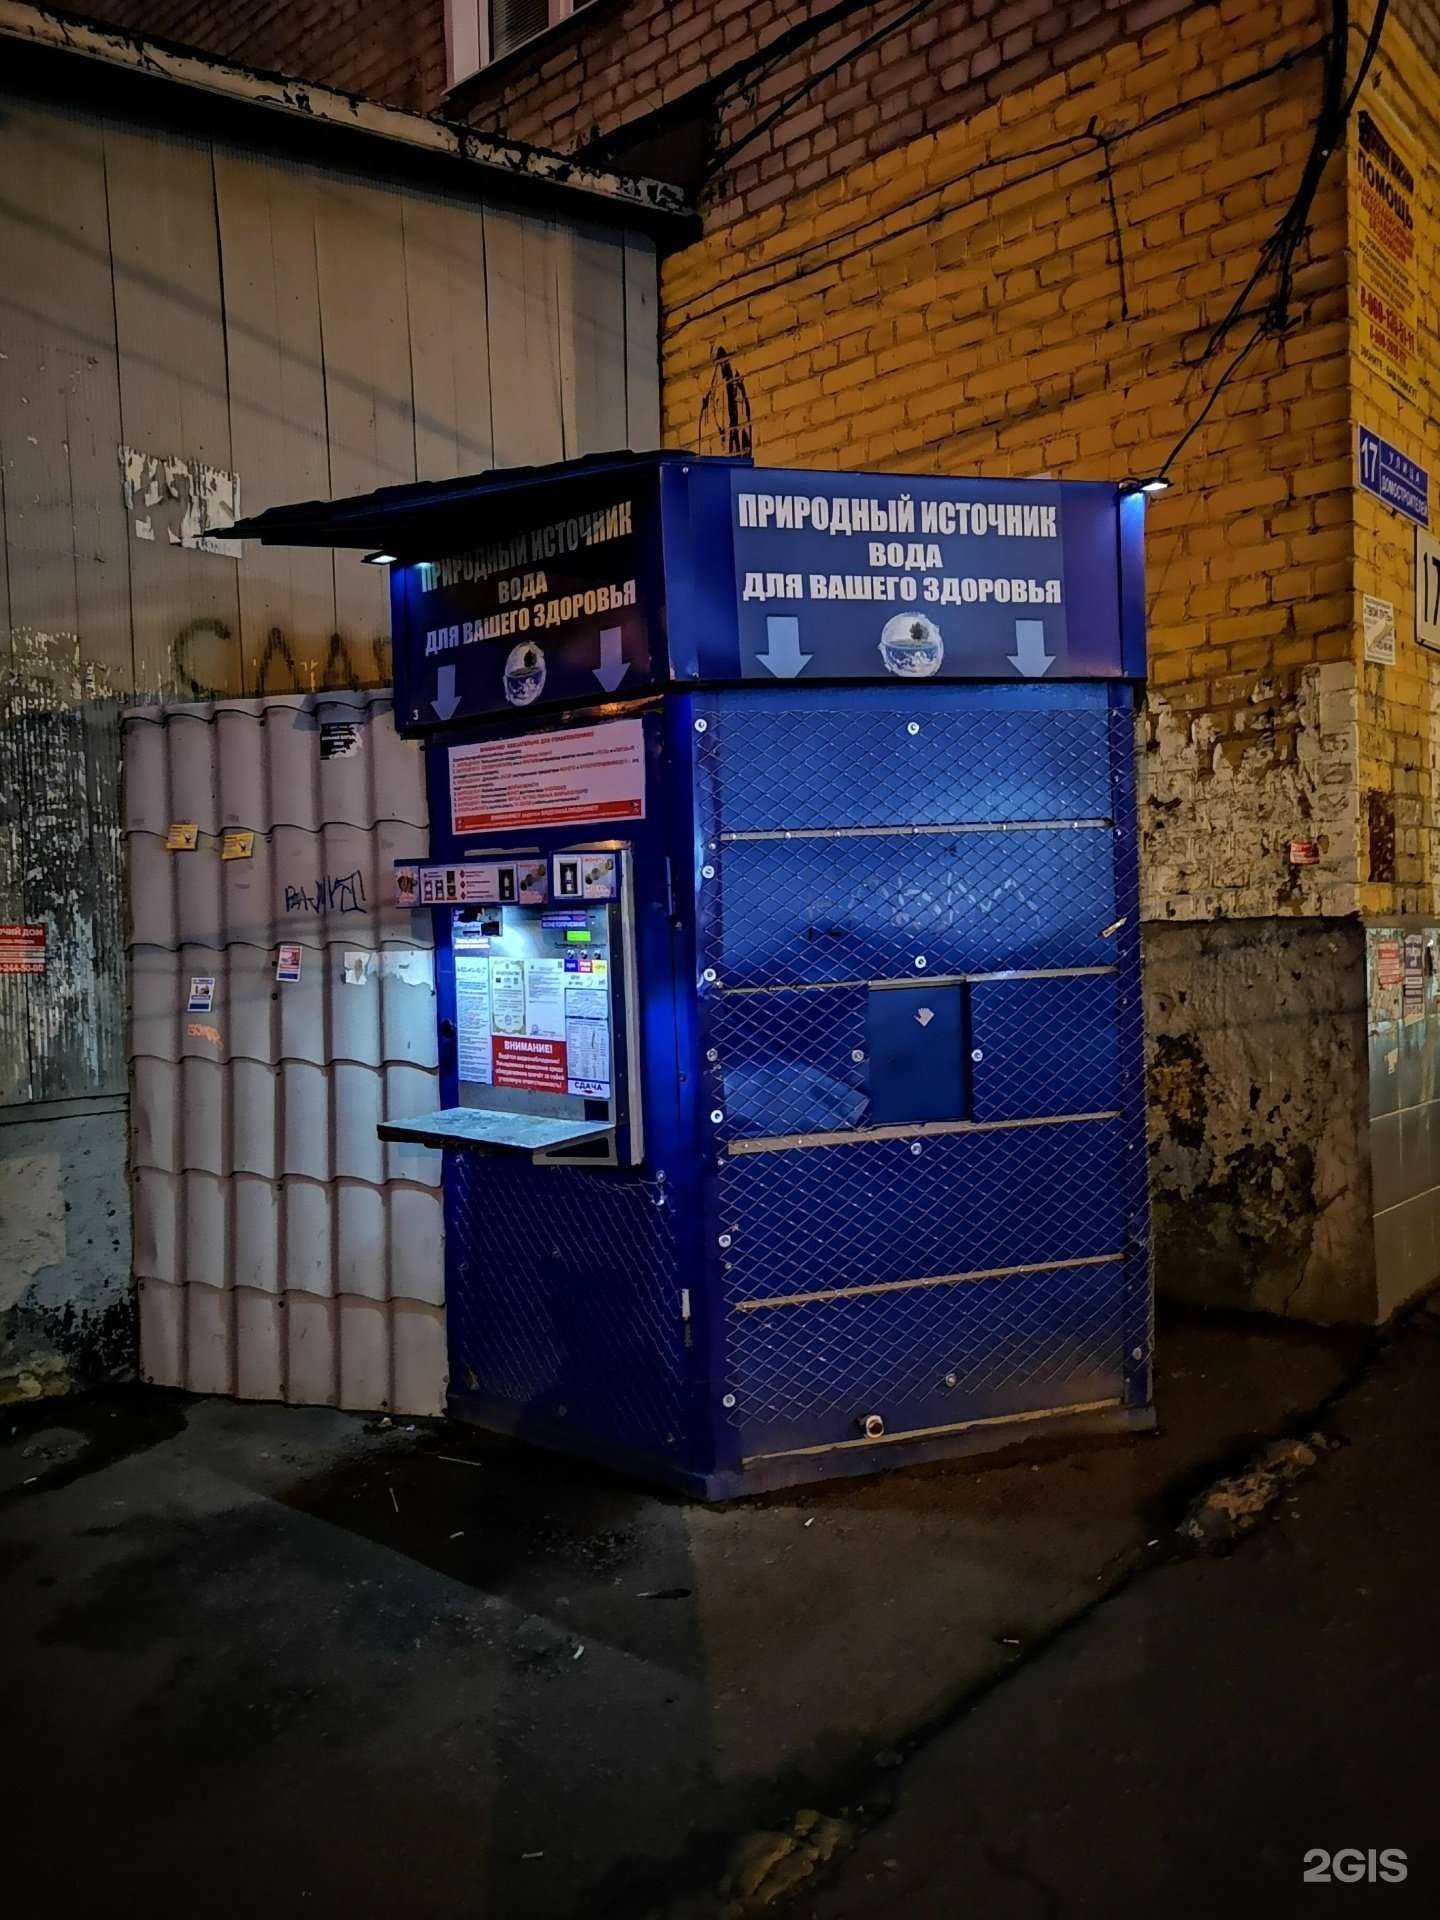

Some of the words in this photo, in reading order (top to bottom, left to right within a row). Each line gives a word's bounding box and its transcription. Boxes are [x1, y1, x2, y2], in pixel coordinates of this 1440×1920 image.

[1361, 438, 1378, 483] 17
[738, 494, 914, 536] ПРИРОДНЫЙ
[921, 501, 1057, 537] ИСТОЧНИК
[421, 531, 528, 592] ПРИРОДНЫЙ
[532, 501, 633, 561] ИСТОЧНИК
[868, 542, 943, 571] ВОДА
[498, 570, 548, 604] ВОДА
[743, 572, 803, 602] ДЛЯ
[809, 574, 917, 601] ВАШЕГО
[923, 576, 1062, 605] ЗДОРОВЬЯ
[425, 625, 459, 657] ДЛЯ
[463, 607, 530, 644] ВАШЕГО
[534, 579, 636, 629] ЗДОРОВЬЯ
[22, 928, 44, 937] ДОМ
[504, 1040, 553, 1054] ВНИМАНИЕ!
[574, 1082, 603, 1091] СДАЧА
